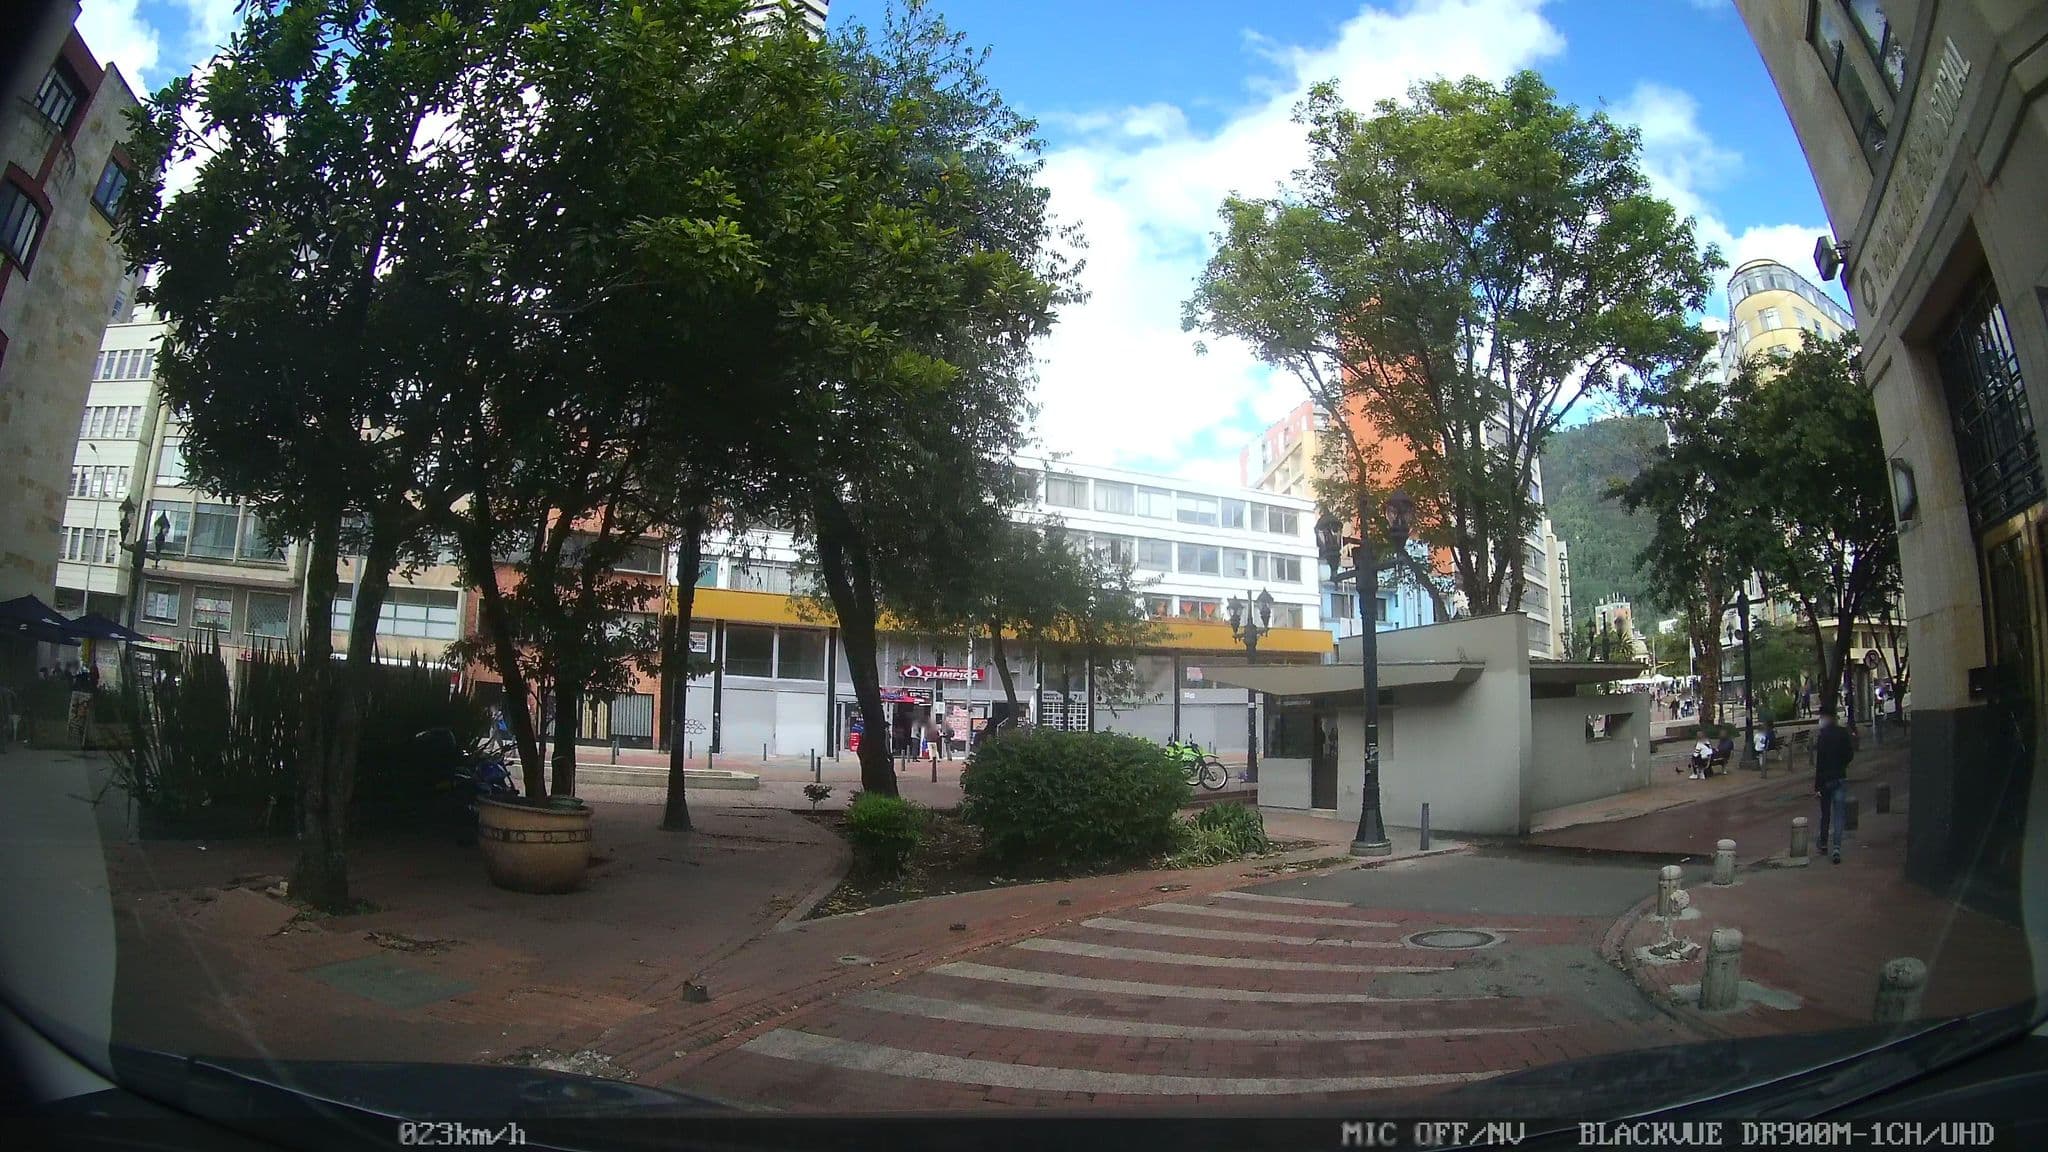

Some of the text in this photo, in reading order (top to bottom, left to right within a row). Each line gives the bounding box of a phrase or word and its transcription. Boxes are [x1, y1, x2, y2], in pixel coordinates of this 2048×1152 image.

[1929, 36, 1972, 138] SOCIAL
[1558, 552, 1571, 660] CONTINENT
[924, 671, 979, 679] OLIMPICA
